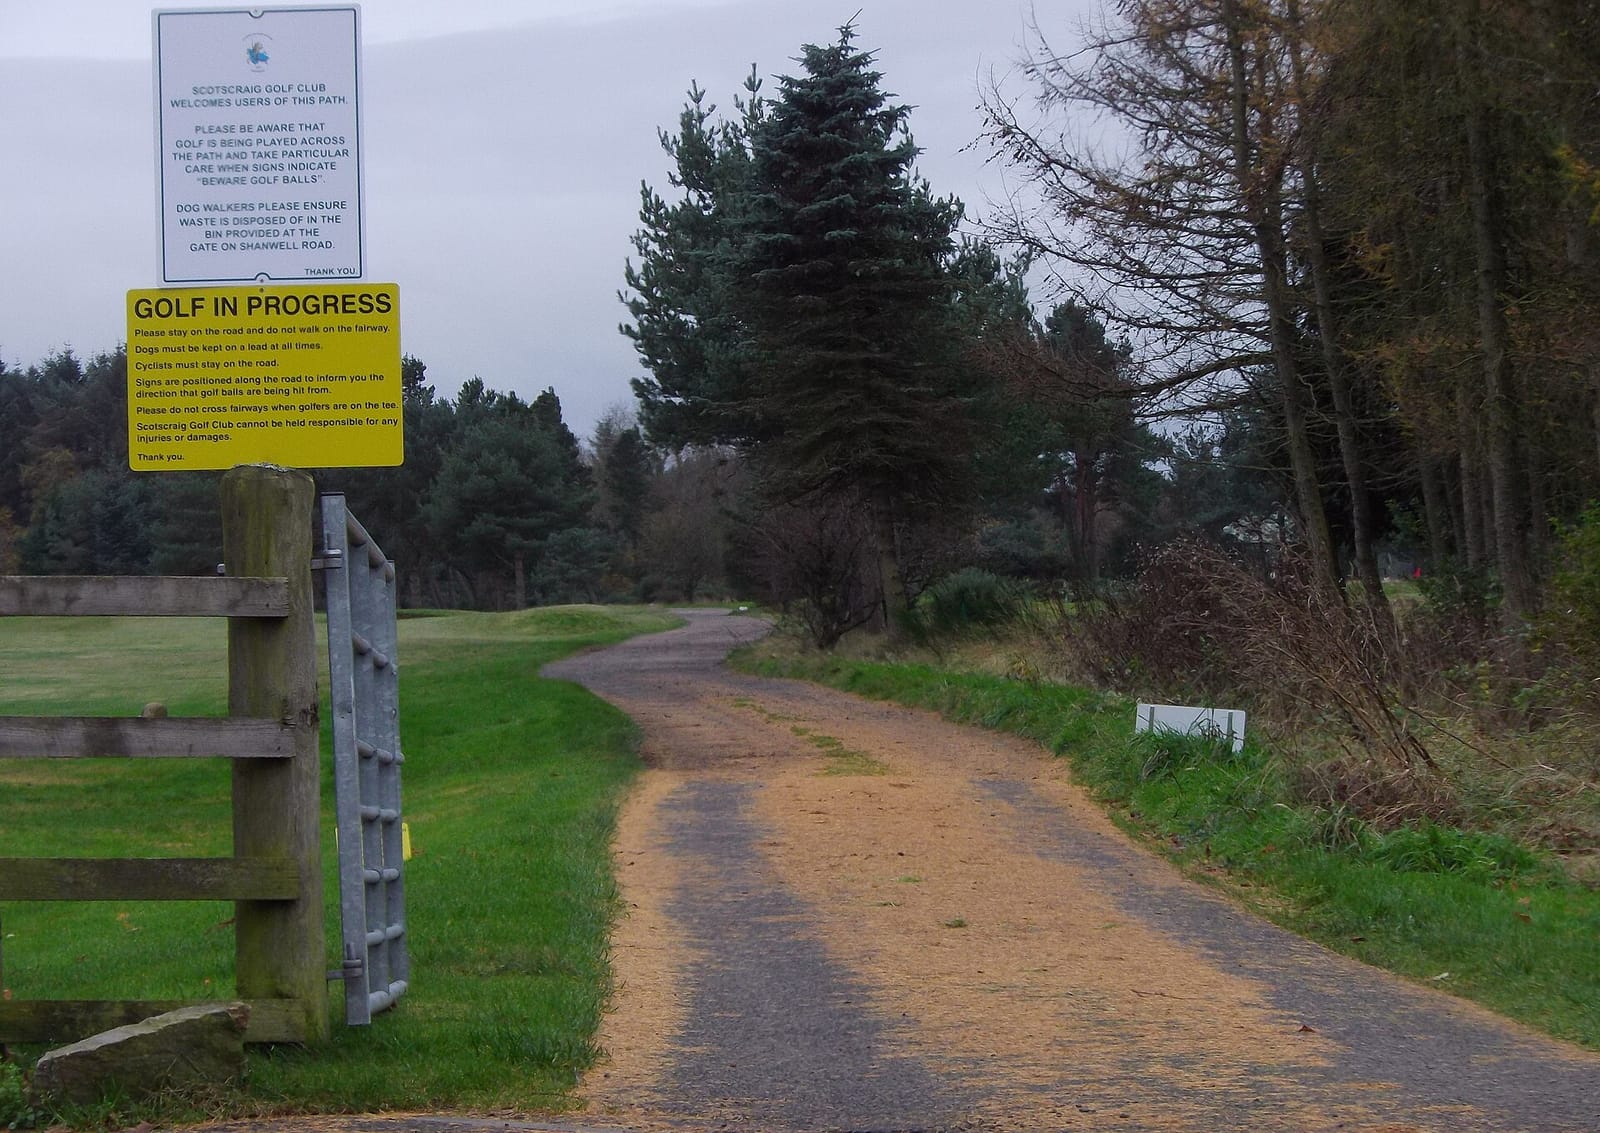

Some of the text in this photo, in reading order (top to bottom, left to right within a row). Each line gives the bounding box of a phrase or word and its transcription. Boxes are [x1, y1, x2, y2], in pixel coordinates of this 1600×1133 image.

[192, 84, 326, 95] SCOTSCRAIG GOLF CLUB
[171, 96, 348, 108] WELCOMES USERS OF THIS PATH.
[195, 123, 325, 134] PLEASE BE AWARE THAT
[175, 136, 345, 148] GOLF IS BEING PLAYED ACROSS
[172, 149, 349, 161] THE PATH AND TAKE PARTICULAR
[185, 162, 337, 173] CARE WHEN SIGNS INDICATE
[250, 176, 279, 184] GOLF
[176, 201, 347, 213] DOG WALKERS PLEASE ENSURE
[180, 215, 341, 226] WASTE IS DISPOSED OF IN THE
[205, 228, 319, 239] BIN PROVIDED AT THE
[190, 241, 335, 252] GATE ON SHANWELL ROAD.
[305, 268, 335, 276] THANK
[134, 293, 392, 319] GOLF IN PROGRESS
[134, 328, 166, 337] Please
[168, 328, 188, 338] stay
[205, 327, 220, 335] the
[222, 327, 244, 335] road
[246, 326, 264, 334] and
[266, 326, 278, 334] do
[322, 325, 334, 333] on
[337, 324, 352, 333] the
[354, 323, 391, 334] fairway.
[135, 345, 160, 355] Dogs
[162, 344, 185, 353] must
[188, 344, 200, 352] be
[202, 343, 223, 353] kept
[248, 342, 268, 350] lead
[282, 342, 293, 350] all
[135, 361, 173, 372] Cyclists
[175, 361, 199, 369] must
[201, 360, 221, 371] stay
[238, 359, 253, 367] the
[255, 359, 279, 367] road.
[136, 377, 163, 387] Signs
[165, 378, 180, 386] are
[182, 376, 232, 386] positioned
[235, 375, 261, 385] along
[264, 375, 278, 383] the
[281, 375, 302, 383] road
[316, 373, 347, 382] inform
[350, 374, 367, 383] you
[369, 373, 385, 381] the
[136, 386, 332, 398] direction that golf balls are being hit from.
[136, 406, 167, 415] Please
[202, 405, 227, 413] cross
[230, 403, 269, 414] fairways
[271, 403, 296, 411] when
[299, 402, 330, 412] golfers
[365, 401, 380, 410] the
[382, 401, 399, 409] tee.
[136, 421, 187, 432] Scotscraig
[189, 421, 210, 430] Golf
[212, 420, 234, 429] Club
[236, 420, 269, 428] cannot
[285, 418, 306, 427] held
[308, 417, 363, 428] responsible
[366, 417, 379, 426] for
[381, 418, 398, 428] any
[137, 434, 172, 444] injuries
[187, 432, 232, 443] damages.
[137, 453, 185, 462] Thank you.
